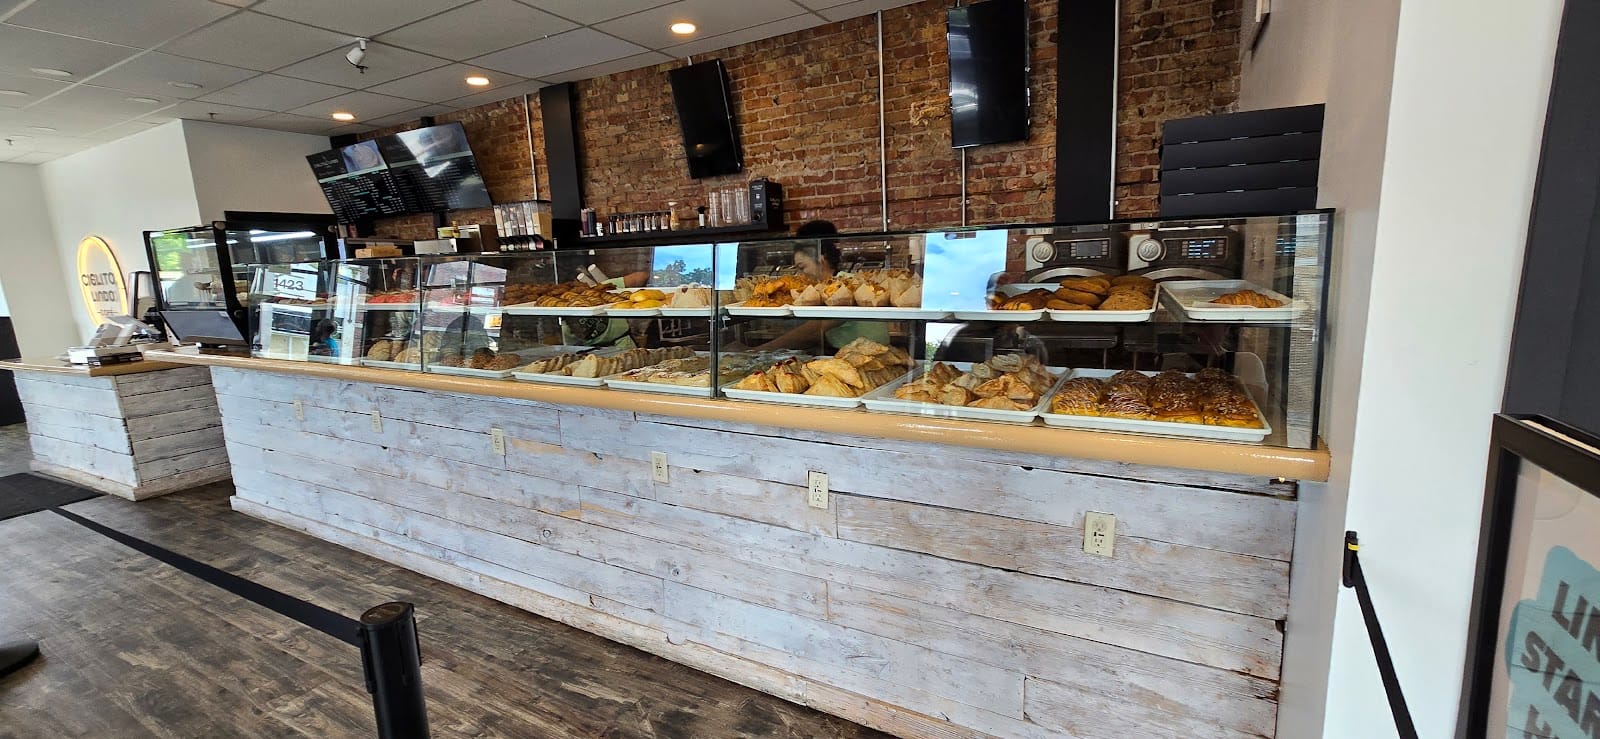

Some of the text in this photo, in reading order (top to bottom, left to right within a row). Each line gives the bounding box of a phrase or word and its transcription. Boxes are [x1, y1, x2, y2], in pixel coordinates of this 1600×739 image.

[81, 272, 116, 287] CIELITO
[274, 278, 304, 291] 1423
[91, 289, 116, 302] LINDO
